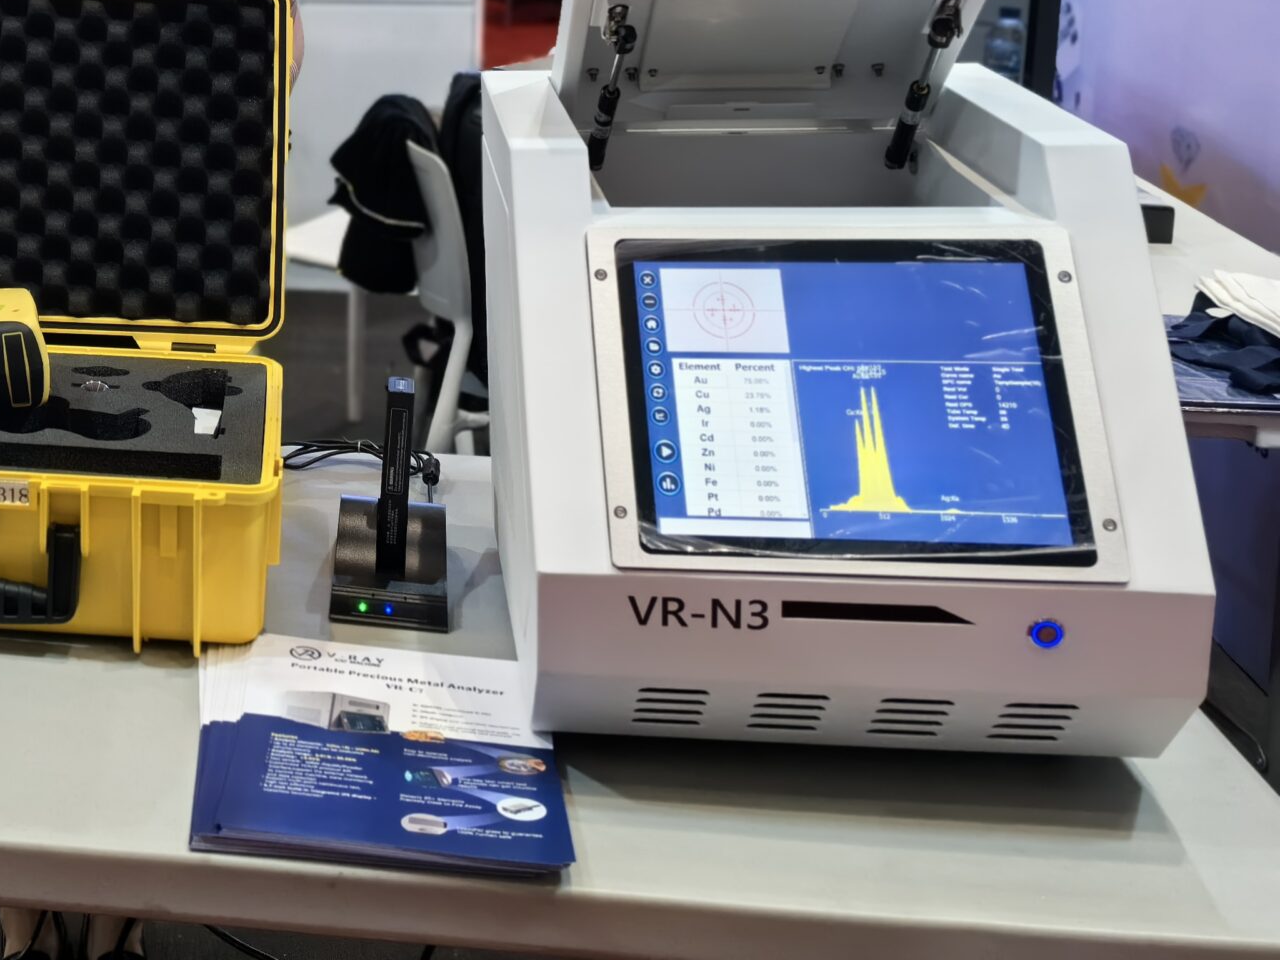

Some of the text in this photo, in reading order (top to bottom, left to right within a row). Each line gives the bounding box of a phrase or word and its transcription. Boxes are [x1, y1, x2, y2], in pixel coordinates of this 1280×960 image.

[679, 361, 776, 372] Element Percent
[694, 375, 708, 385] Au
[695, 390, 710, 399] Cu
[696, 404, 711, 414] Ag
[700, 433, 714, 442] Cd
[701, 448, 715, 457] Zn
[704, 463, 716, 472] Ni
[705, 478, 718, 487] Fe
[707, 493, 719, 502] Pt
[707, 507, 722, 517] Pd
[627, 595, 771, 631] VR-N3
[290, 661, 506, 696] Portable Precious Metal Analyzer
